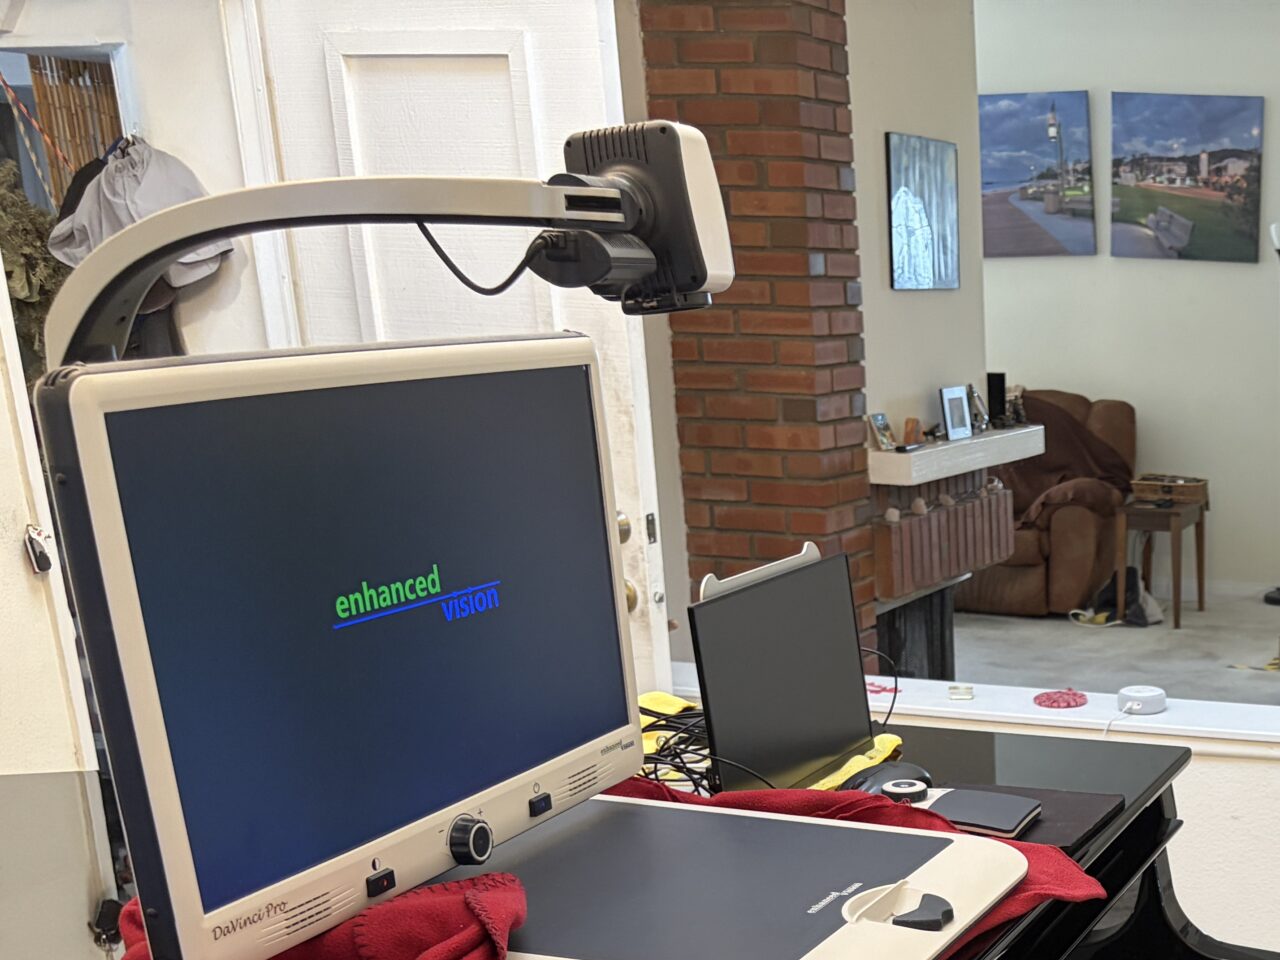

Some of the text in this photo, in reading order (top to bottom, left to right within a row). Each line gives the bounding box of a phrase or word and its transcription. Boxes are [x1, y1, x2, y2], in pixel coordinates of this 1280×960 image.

[336, 564, 441, 618] enhanced
[442, 586, 500, 621] vision
[212, 901, 288, 940] DaVinci Pro
